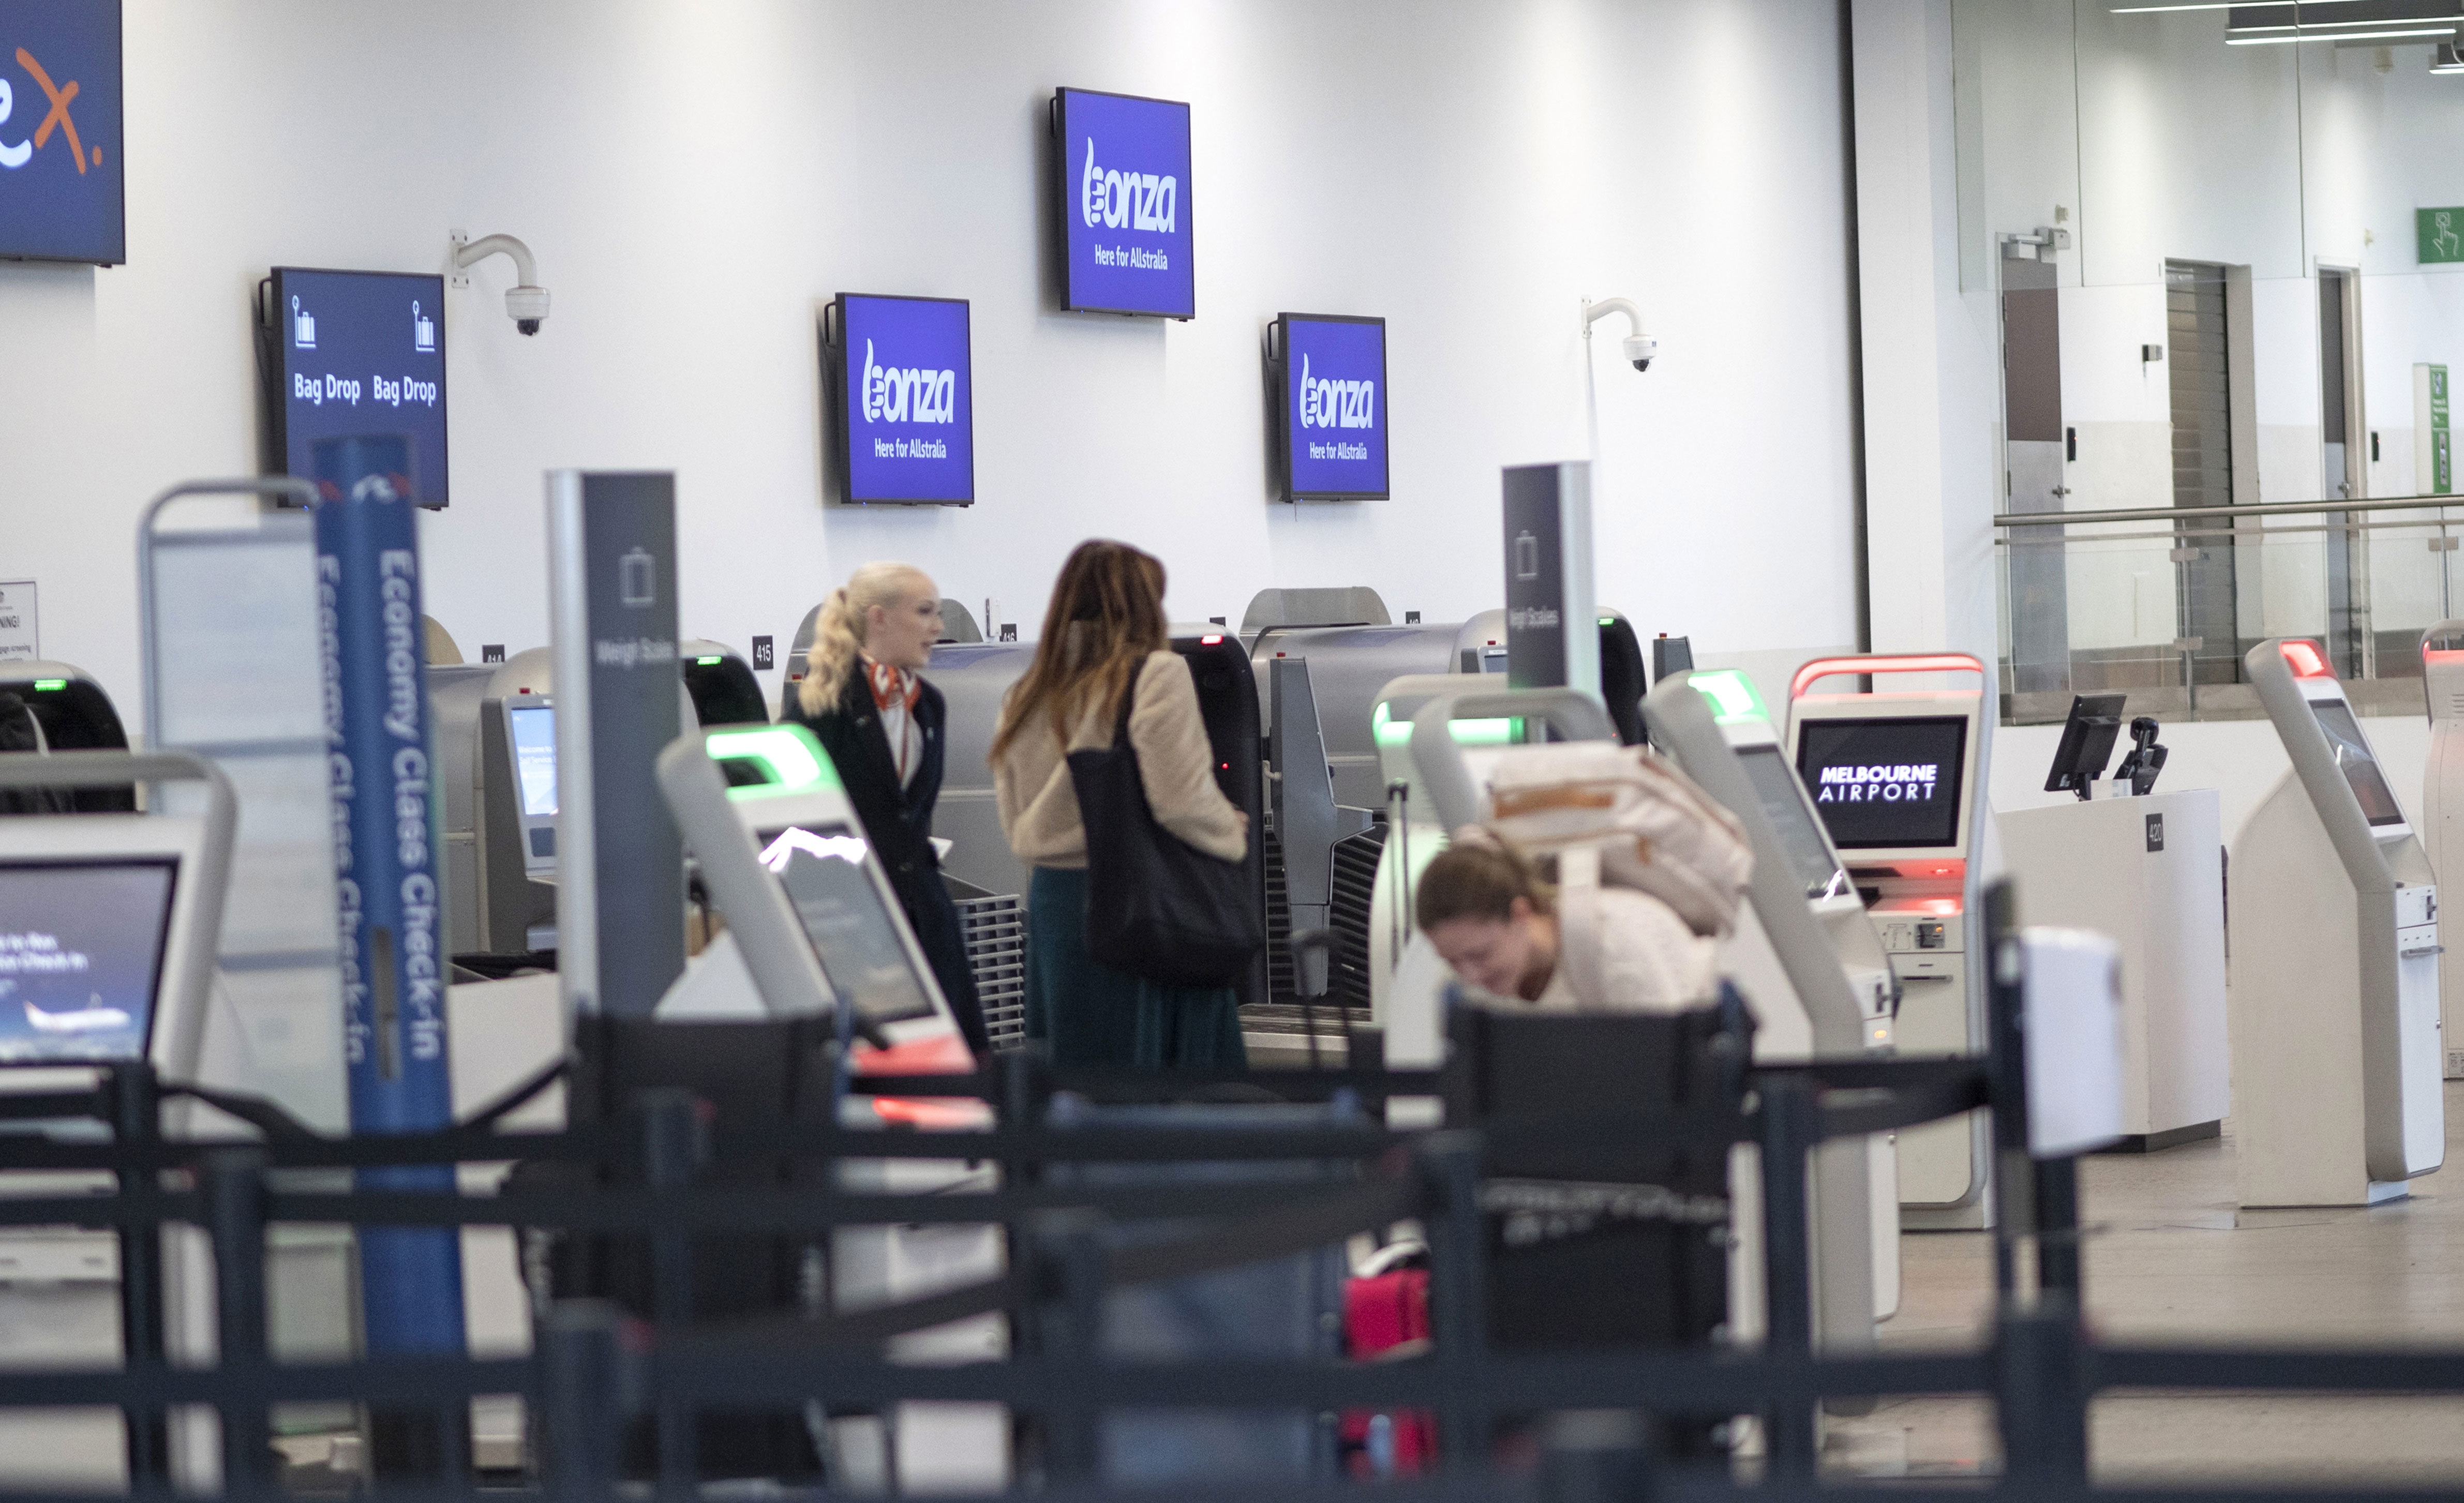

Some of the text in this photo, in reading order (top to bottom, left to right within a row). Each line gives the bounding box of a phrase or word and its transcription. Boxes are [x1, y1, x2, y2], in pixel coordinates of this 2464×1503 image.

[1082, 137, 1176, 233] bonza
[1095, 244, 1168, 270] Here for Allstralia
[294, 373, 361, 405] Bag Drop
[374, 375, 436, 407] Bag Drop
[862, 338, 955, 424] bonza
[1300, 353, 1374, 429] bonza
[875, 438, 947, 458] Here for Allstralia
[1310, 442, 1325, 459] Here
[1326, 442, 1337, 459] for
[380, 549, 421, 741] Economy
[757, 644, 771, 662] 415
[1820, 764, 1938, 785] MELBOURNE
[1818, 783, 1936, 802] AIRPORT
[393, 747, 429, 869] Class
[2149, 823, 2162, 842] 420
